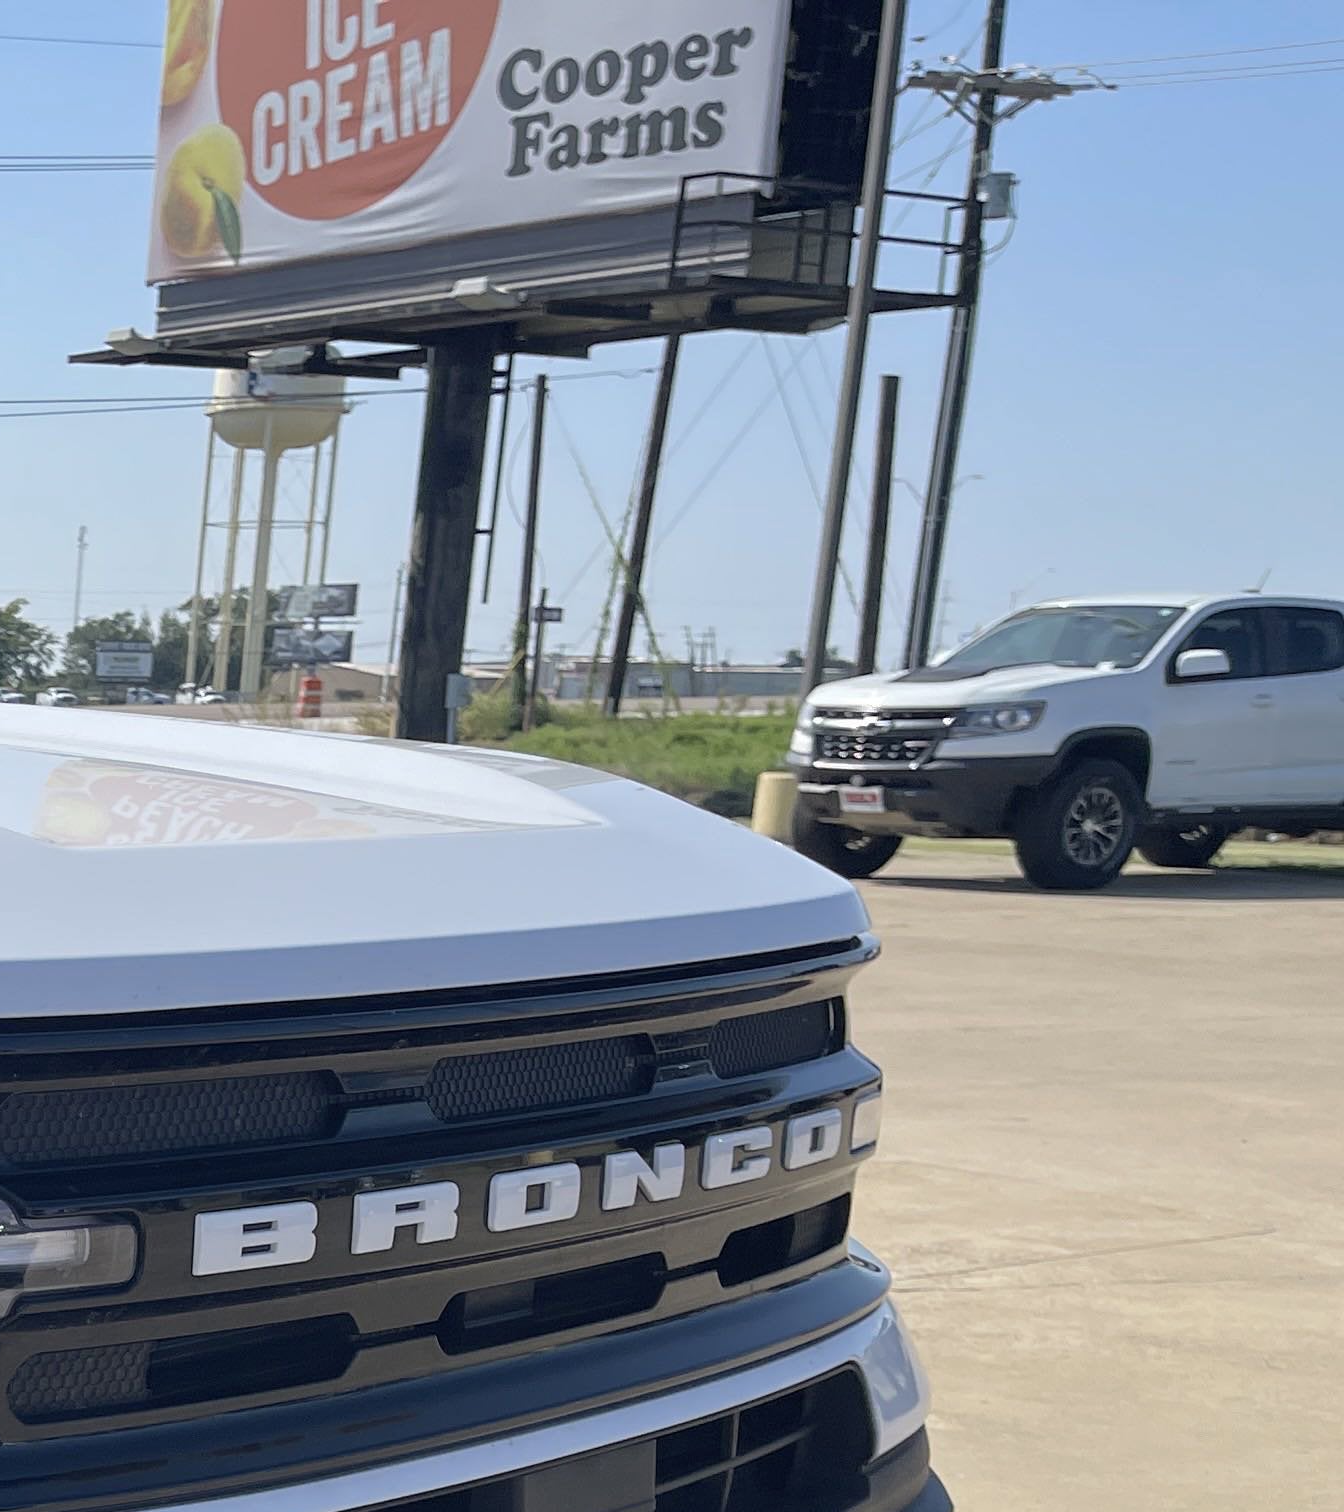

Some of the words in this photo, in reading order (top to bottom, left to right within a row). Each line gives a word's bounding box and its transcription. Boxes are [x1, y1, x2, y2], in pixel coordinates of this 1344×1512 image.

[305, 0, 395, 70] ICE
[496, 25, 755, 112] Cooper
[251, 27, 451, 186] CREAM
[506, 99, 727, 178] Farms
[192, 1107, 842, 1278] BRONCO
